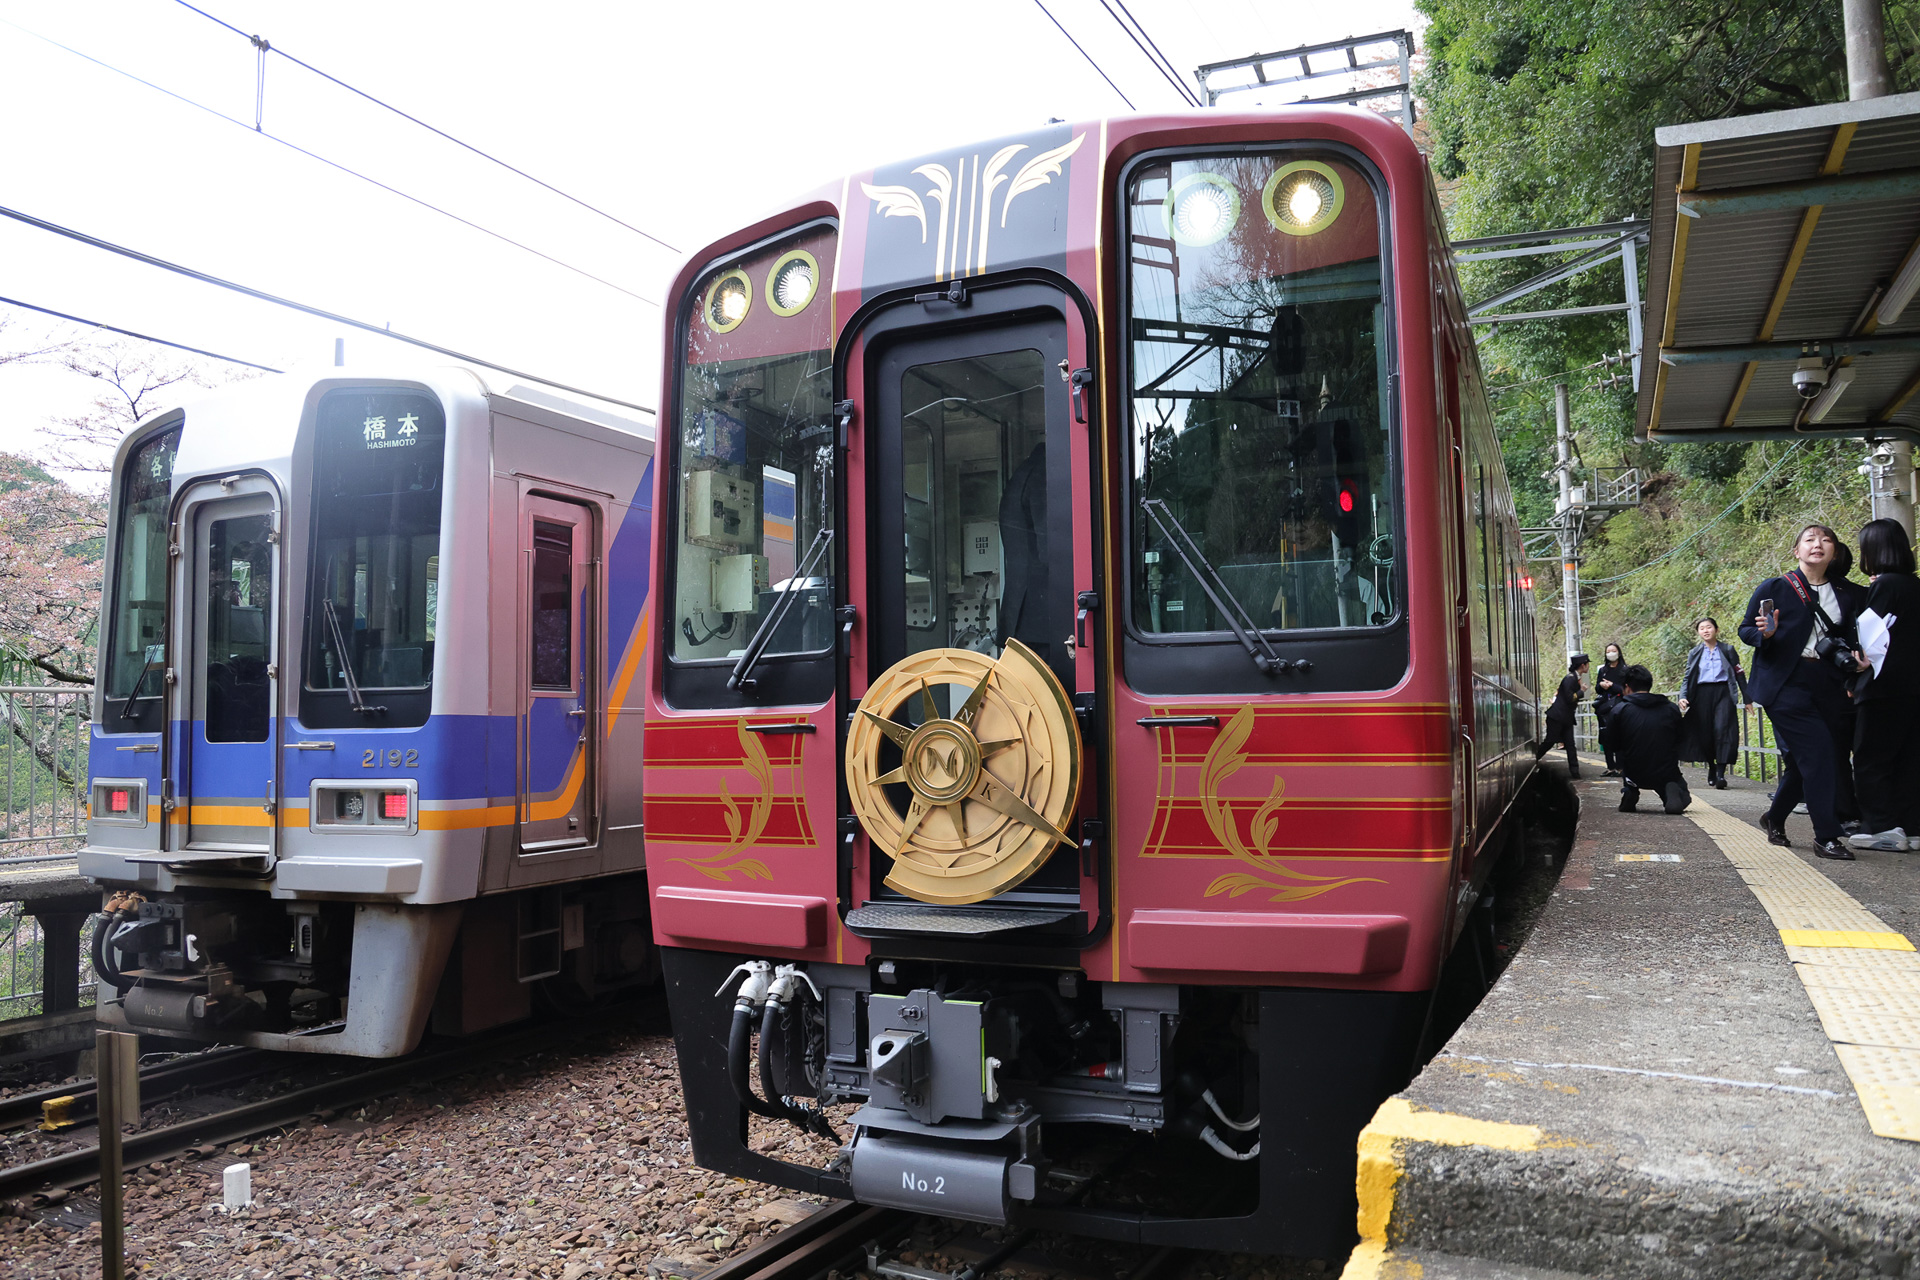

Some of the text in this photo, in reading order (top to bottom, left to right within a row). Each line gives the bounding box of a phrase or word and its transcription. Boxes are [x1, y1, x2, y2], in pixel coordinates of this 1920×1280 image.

[362, 412, 419, 441] 橋本
[367, 438, 416, 450] HASHIMOTO
[959, 708, 974, 723] N
[894, 729, 908, 744] K
[362, 749, 419, 768] 2192
[980, 781, 998, 802] K
[911, 801, 926, 817] W
[902, 1171, 945, 1195] No.2
